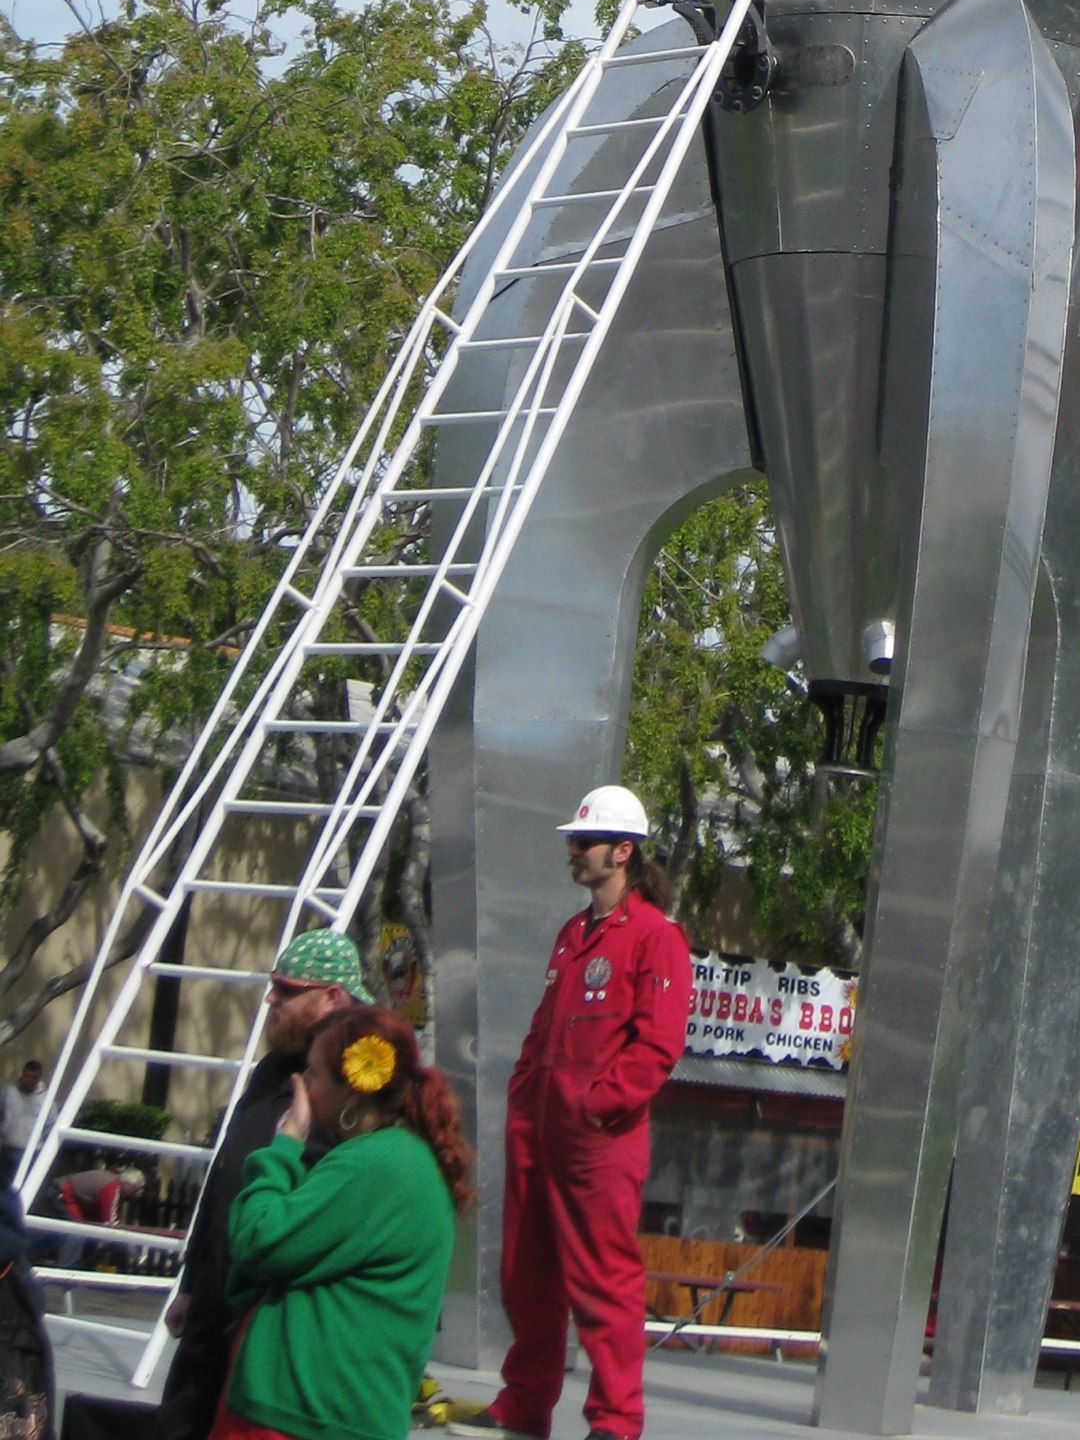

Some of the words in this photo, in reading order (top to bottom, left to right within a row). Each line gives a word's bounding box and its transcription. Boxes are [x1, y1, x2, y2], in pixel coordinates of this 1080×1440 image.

[691, 964, 752, 987] RI-TIP
[777, 976, 821, 997] RIBS
[687, 988, 783, 1027] BUBBA'S
[702, 1024, 745, 1042] PORK
[765, 1031, 834, 1052] CHICKEN
